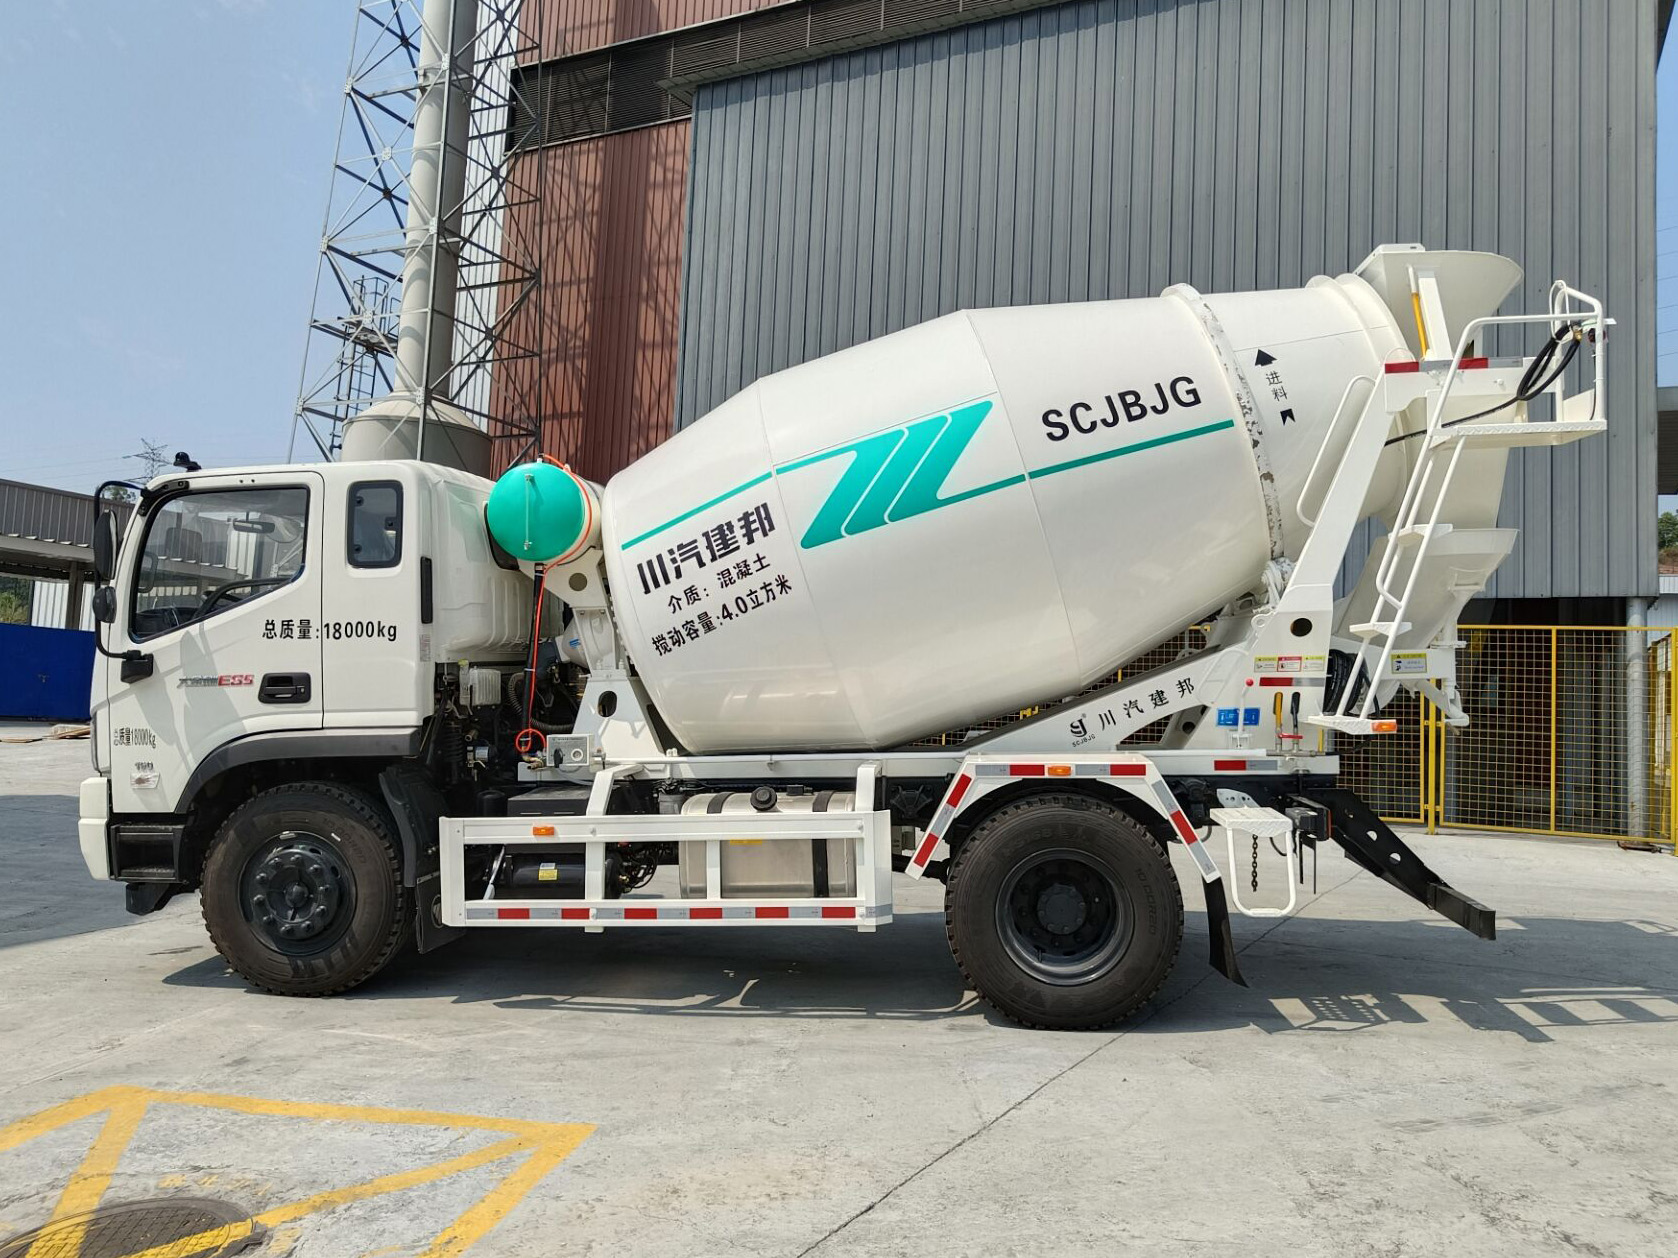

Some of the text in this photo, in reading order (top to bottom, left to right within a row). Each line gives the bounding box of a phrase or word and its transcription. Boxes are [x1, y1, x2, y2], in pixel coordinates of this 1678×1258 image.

[1041, 376, 1202, 442] SCJBJG
[1265, 370, 1288, 402] 进料
[636, 502, 776, 595] 川汽建邦
[262, 619, 398, 642] 总质量:18000kg
[1097, 676, 1195, 731] 川汽建邦
